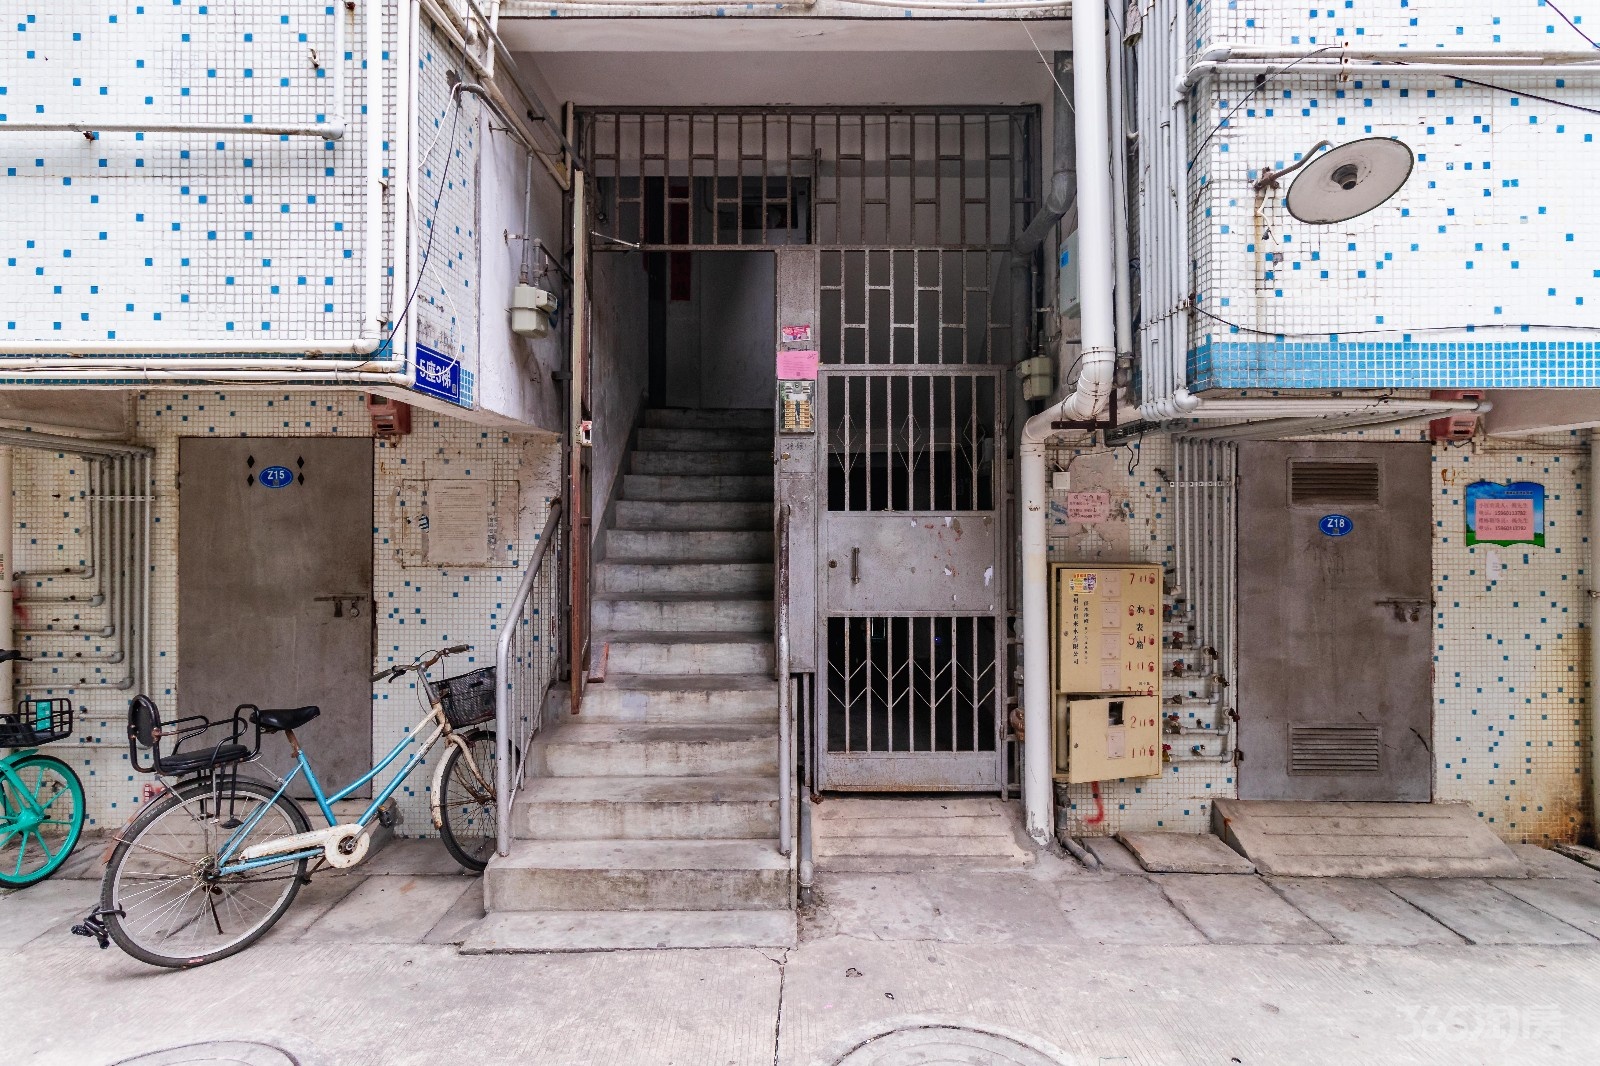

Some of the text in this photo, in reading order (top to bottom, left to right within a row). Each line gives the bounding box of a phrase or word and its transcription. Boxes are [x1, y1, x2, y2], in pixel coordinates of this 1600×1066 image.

[420, 359, 451, 388] 5座3梯
[267, 470, 285, 480] Z15
[1327, 518, 1345, 528] Z18
[1136, 604, 1144, 650] 水表箱
